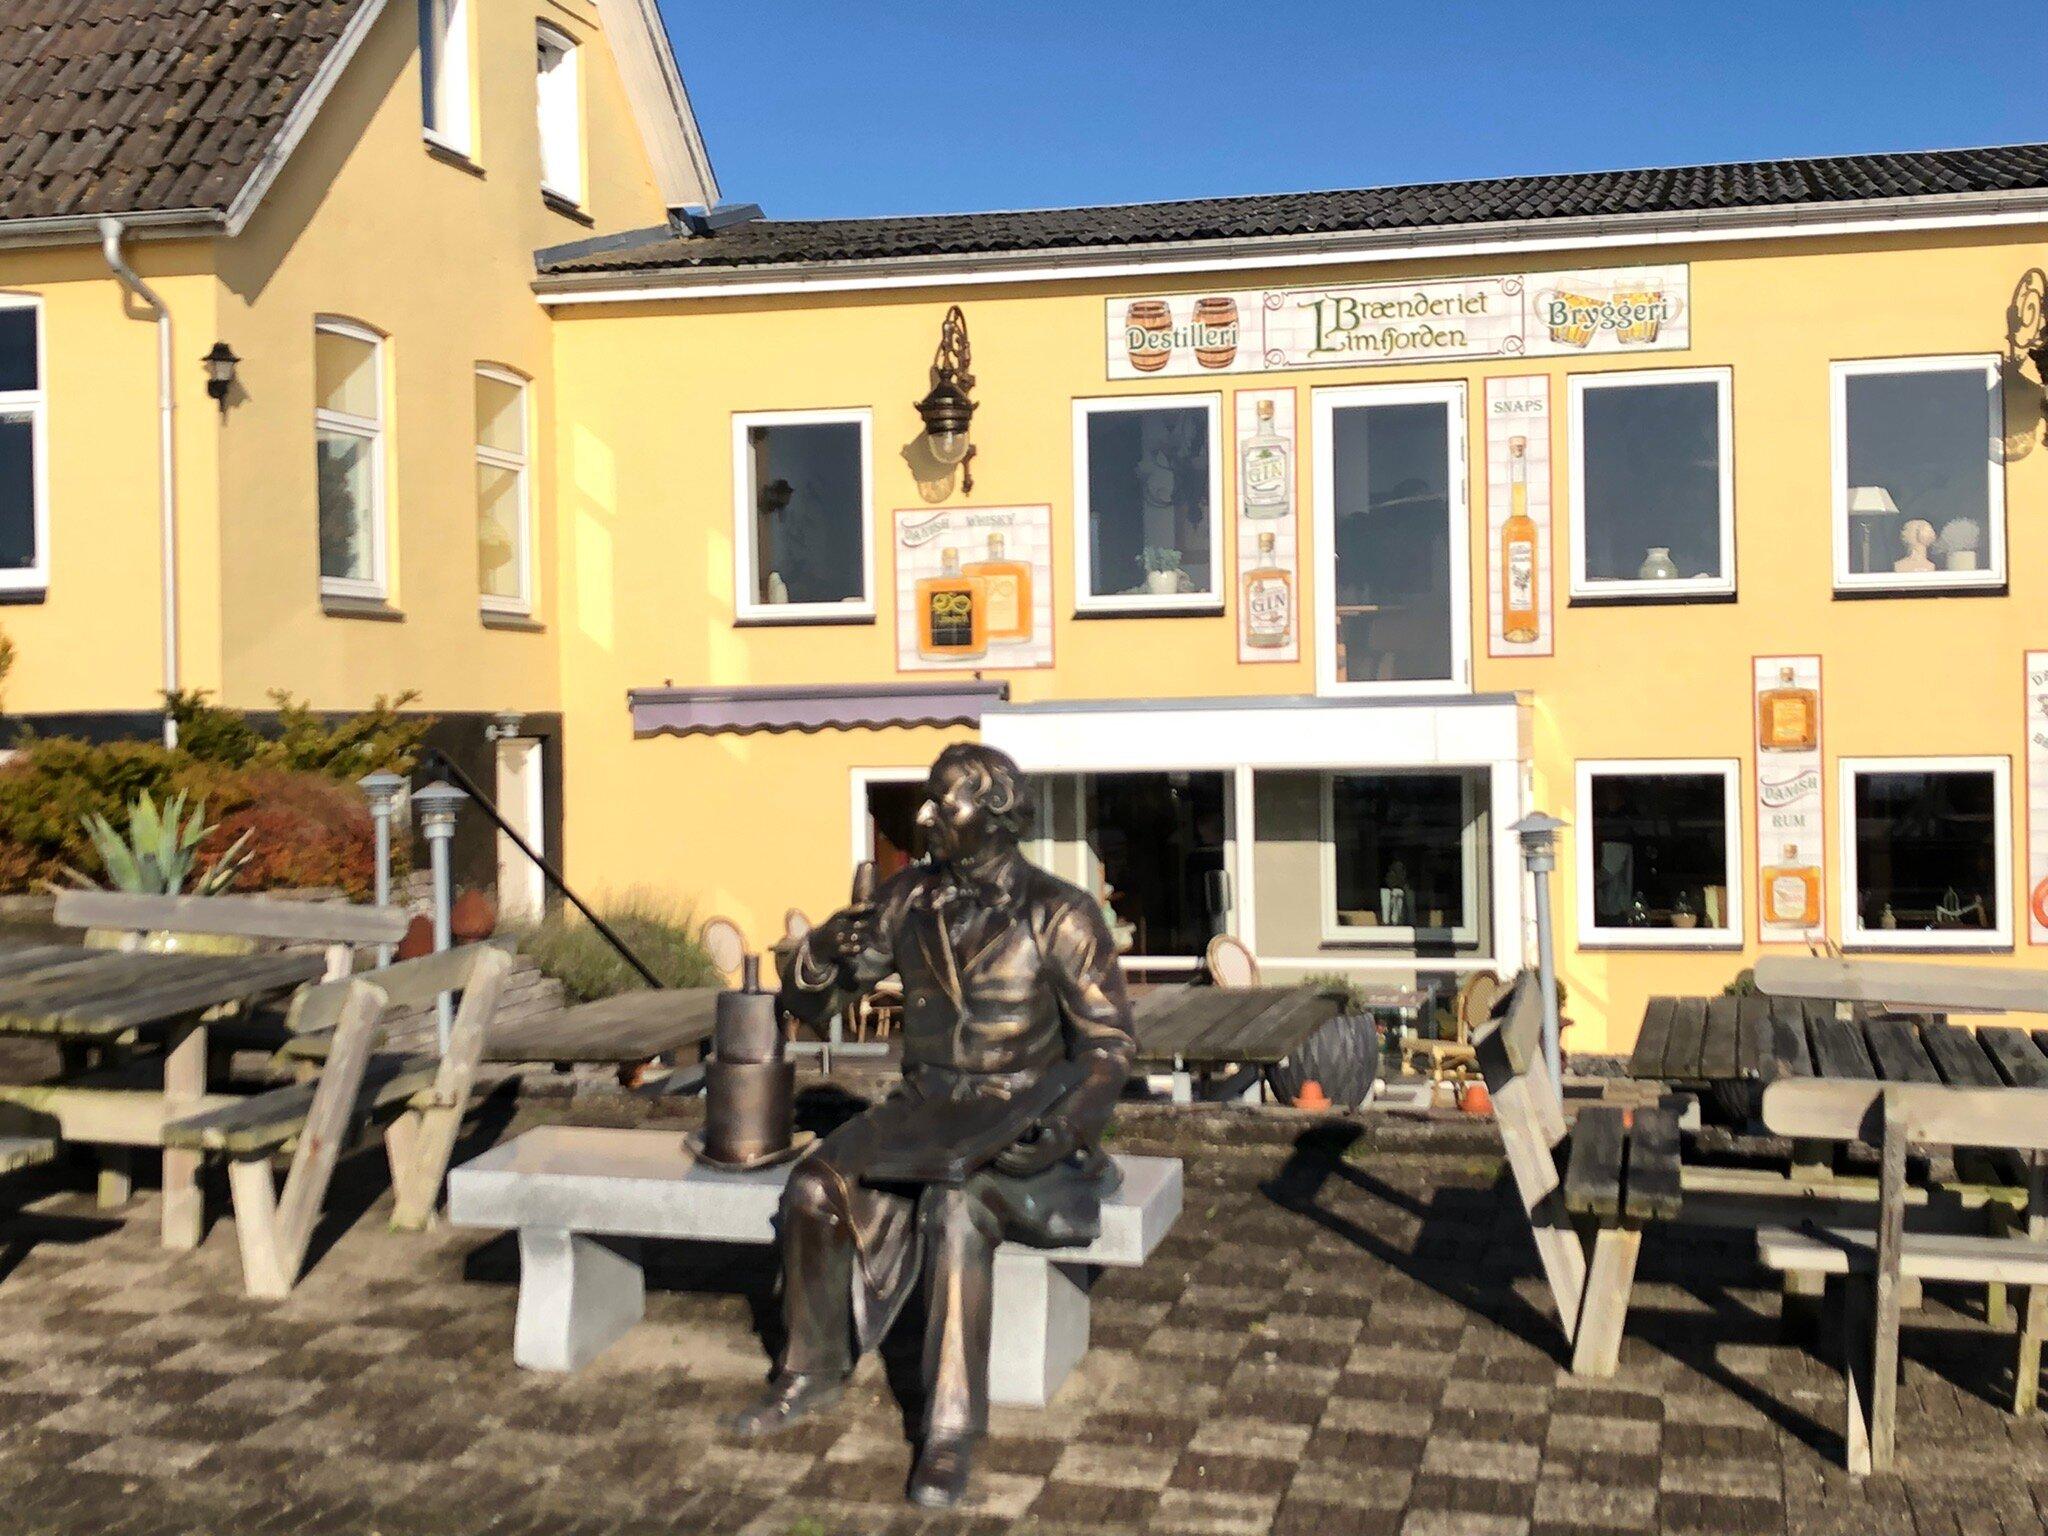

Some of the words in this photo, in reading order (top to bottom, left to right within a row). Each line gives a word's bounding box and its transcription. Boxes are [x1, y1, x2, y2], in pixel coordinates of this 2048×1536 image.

[1325, 291, 1488, 338] Brænderiet
[1548, 297, 1668, 330] Bryggeri
[1126, 322, 1238, 350] Destilleri
[1297, 299, 1468, 358] Limfjorden
[1493, 400, 1544, 414] SNAPS
[1249, 460, 1283, 483] GIN
[966, 512, 1016, 527] WHISKY
[1252, 588, 1286, 612] GIN
[1764, 776, 1818, 800] DANISH
[1772, 814, 1806, 828] RUM
